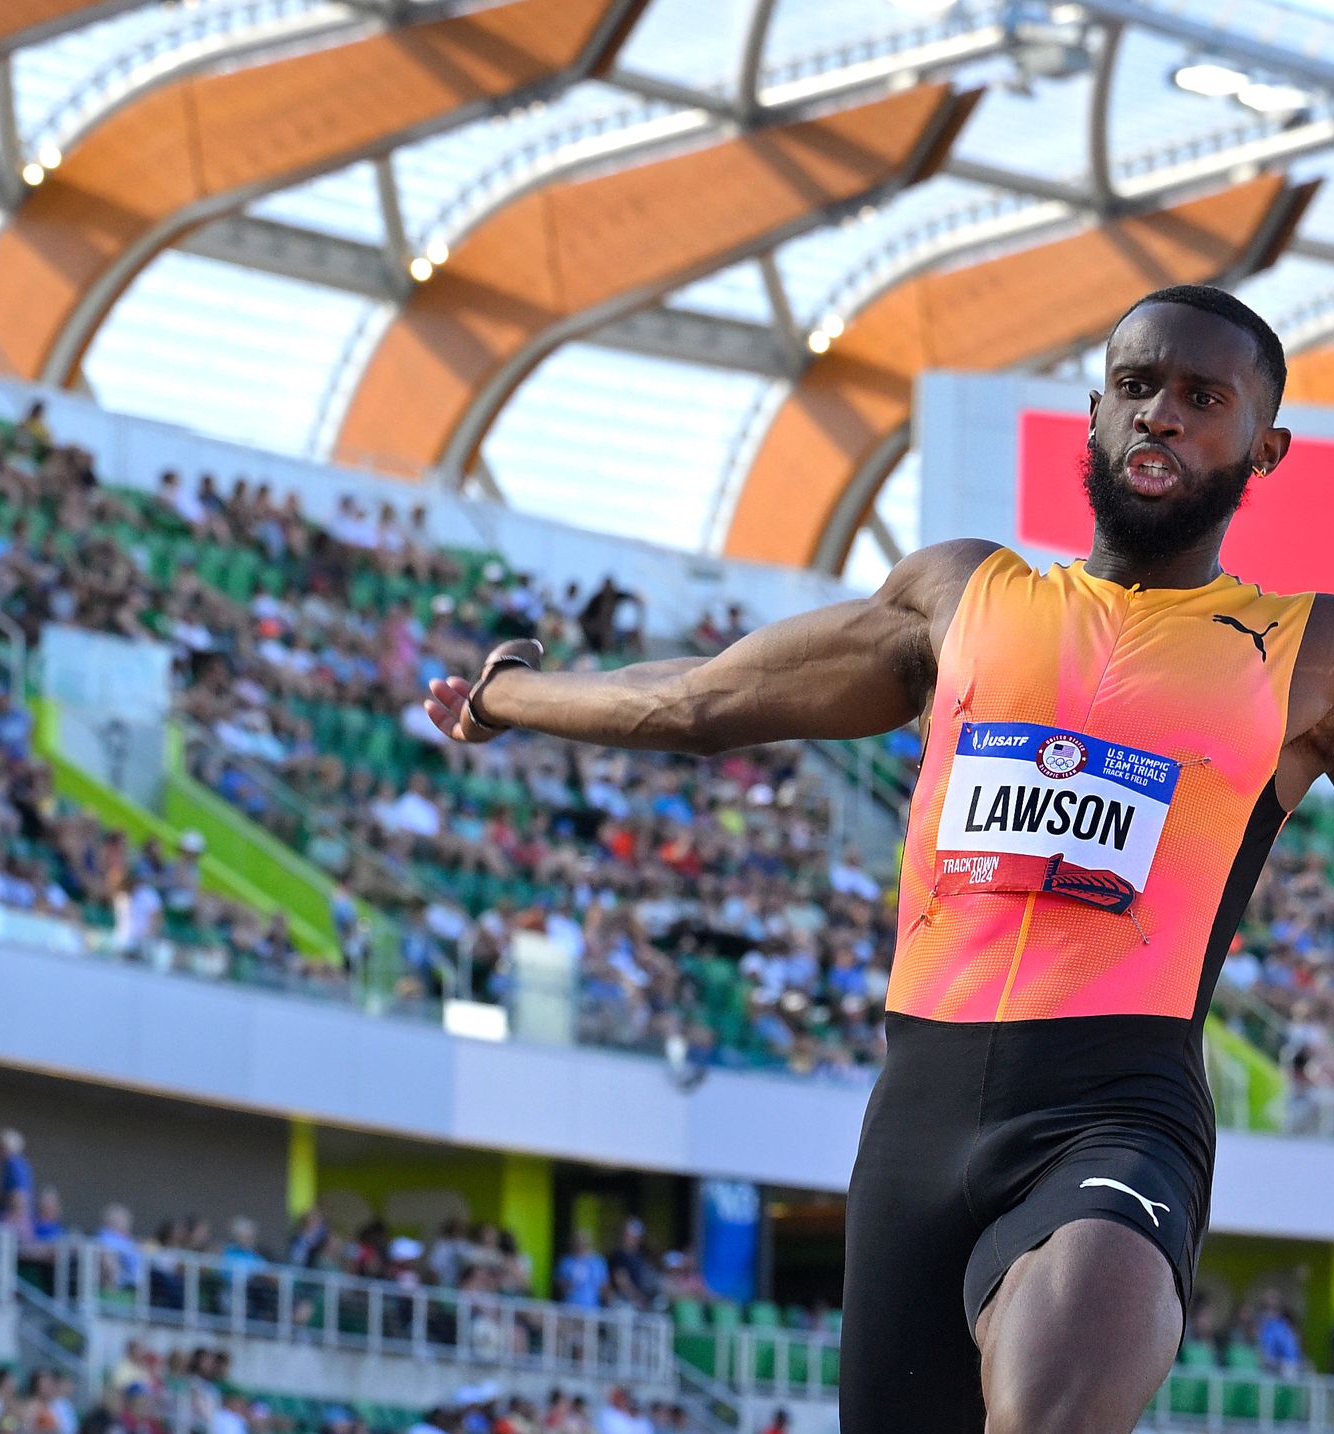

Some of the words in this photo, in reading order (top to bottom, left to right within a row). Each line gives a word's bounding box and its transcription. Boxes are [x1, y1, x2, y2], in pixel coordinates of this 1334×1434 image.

[987, 737, 1029, 747] USATF
[1107, 747, 1125, 761] U.S.
[1128, 753, 1170, 772] OLYMPIC
[1102, 767, 1124, 779] TRACK
[1130, 774, 1148, 787] FIELD
[1104, 757, 1131, 772] TEAM
[1133, 764, 1167, 783] TRIALS
[965, 785, 1135, 851] LAWSON
[943, 855, 1000, 874] TRACKTOWN
[969, 868, 994, 884] 2024
